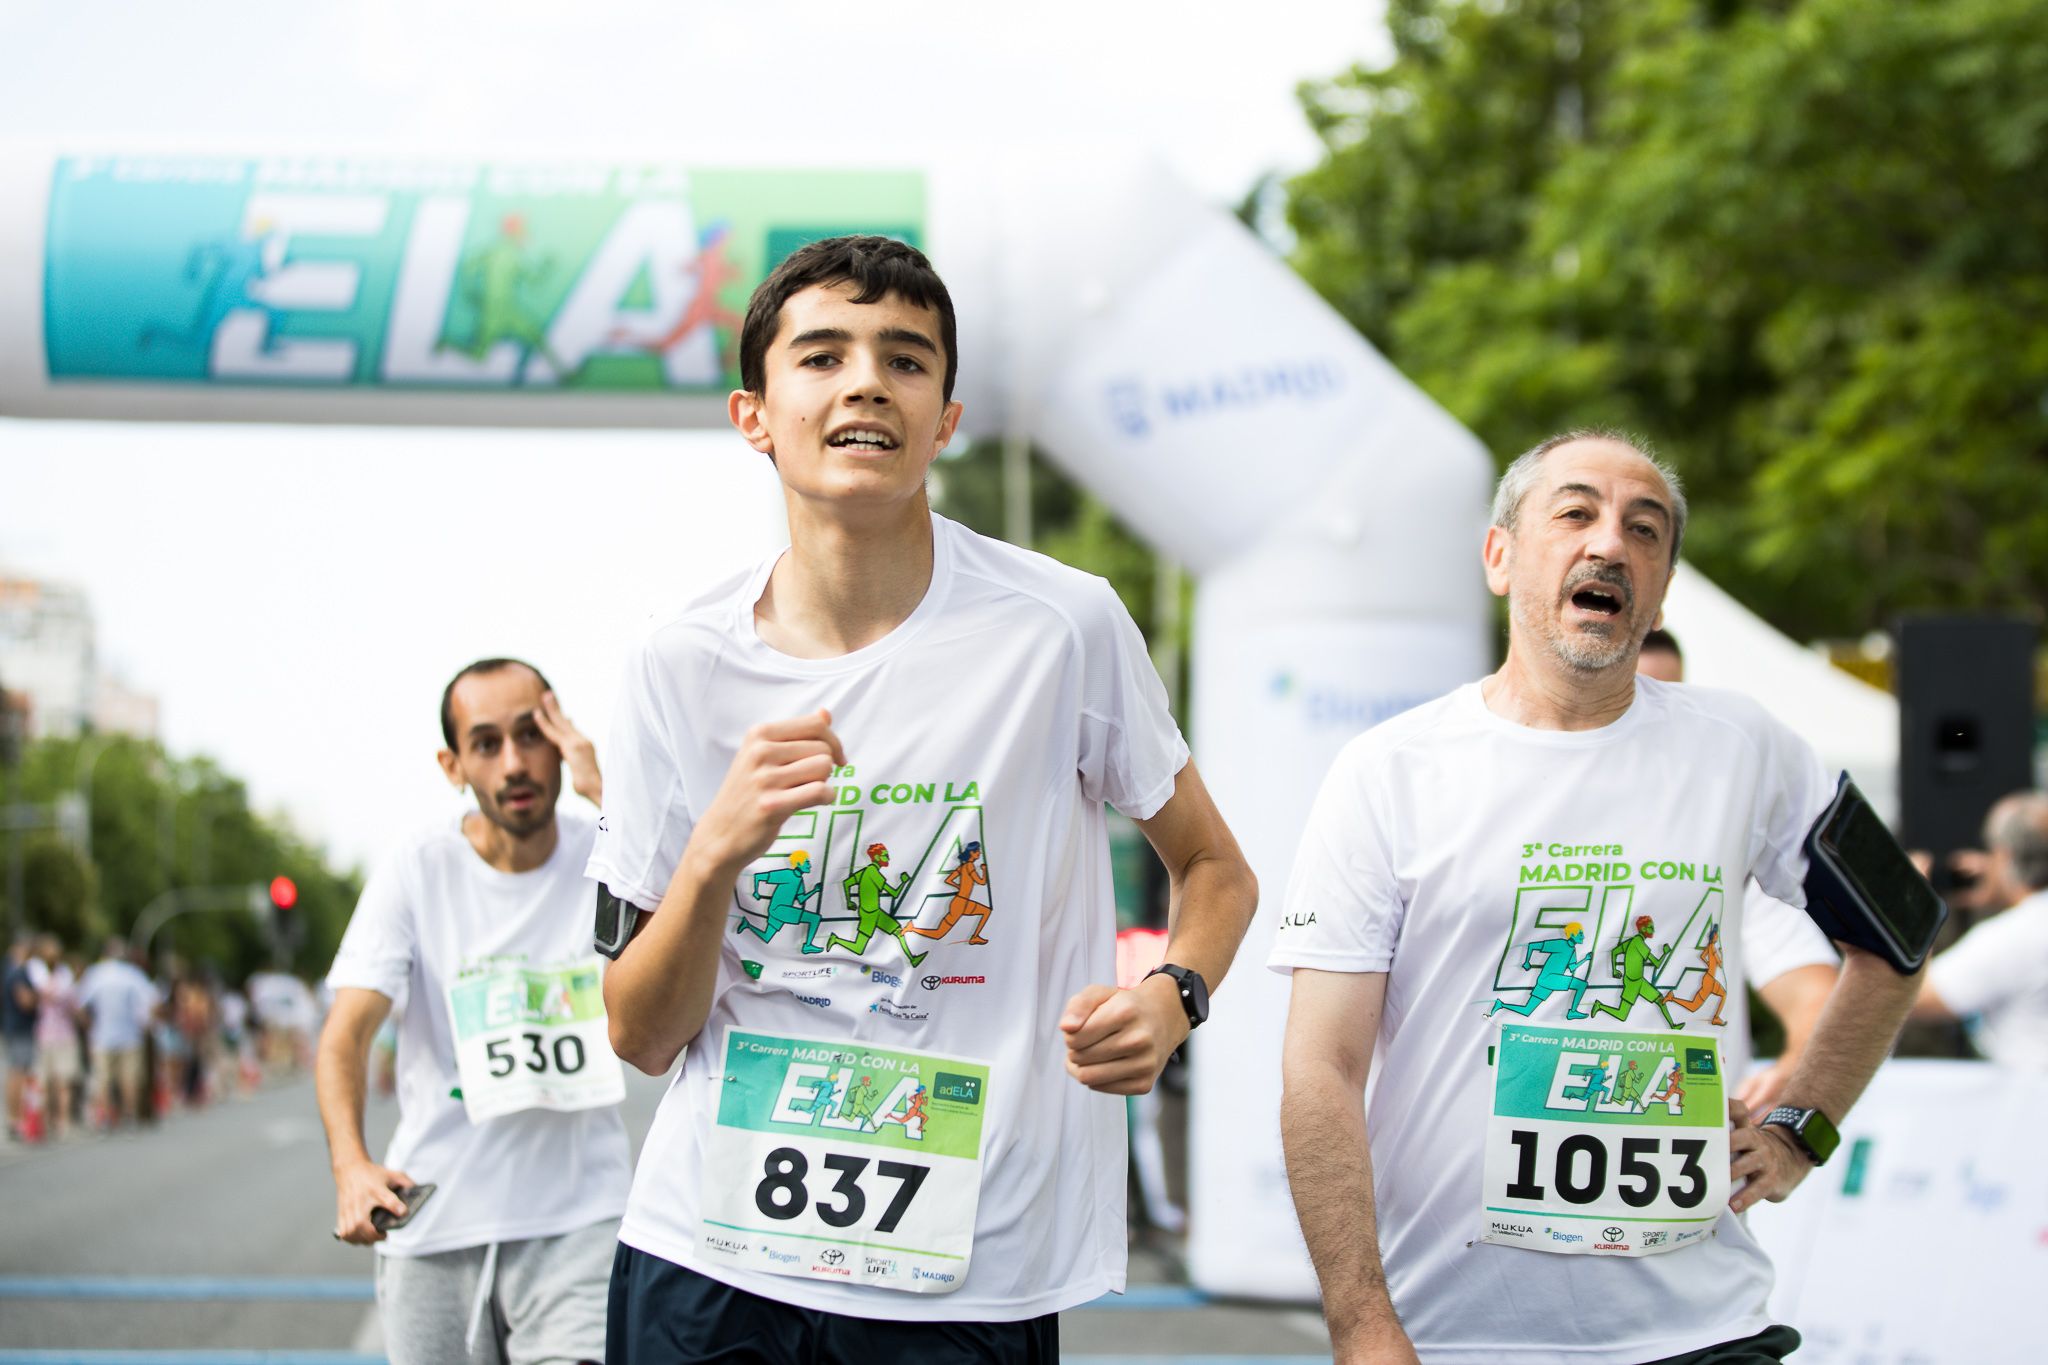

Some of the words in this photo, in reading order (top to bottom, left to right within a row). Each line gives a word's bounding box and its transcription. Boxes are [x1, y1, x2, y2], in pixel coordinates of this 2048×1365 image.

[209, 193, 722, 387] ELA
[869, 782, 936, 805] CON
[943, 781, 980, 802] LA
[1521, 842, 1543, 858] 3ª
[1548, 842, 1623, 857] Carrera
[1519, 862, 1632, 883] MADRID
[1639, 861, 1696, 881] CON
[1702, 864, 1724, 885] LA
[1493, 885, 1728, 991] ELA
[485, 978, 575, 1026] ELA
[486, 1032, 586, 1078] 530
[1521, 1033, 1559, 1046] Carrera
[1562, 1036, 1624, 1052] MADRID
[1626, 1040, 1657, 1053] CON
[1659, 1041, 1675, 1053] LA
[750, 1042, 789, 1057] Carrera
[792, 1046, 857, 1065] MADRID
[860, 1054, 897, 1072] CON
[899, 1060, 920, 1075] LA
[1544, 1051, 1683, 1116] ELA
[769, 1062, 923, 1141] ELA
[1506, 1129, 1708, 1209] 1053
[755, 1147, 931, 1233] 837
[1492, 1222, 1534, 1234] MUKUA
[1552, 1231, 1584, 1243] Biogen
[769, 1249, 801, 1263] Biogen
[867, 1265, 888, 1274] LIFE
[922, 1271, 955, 1283] MADRID
